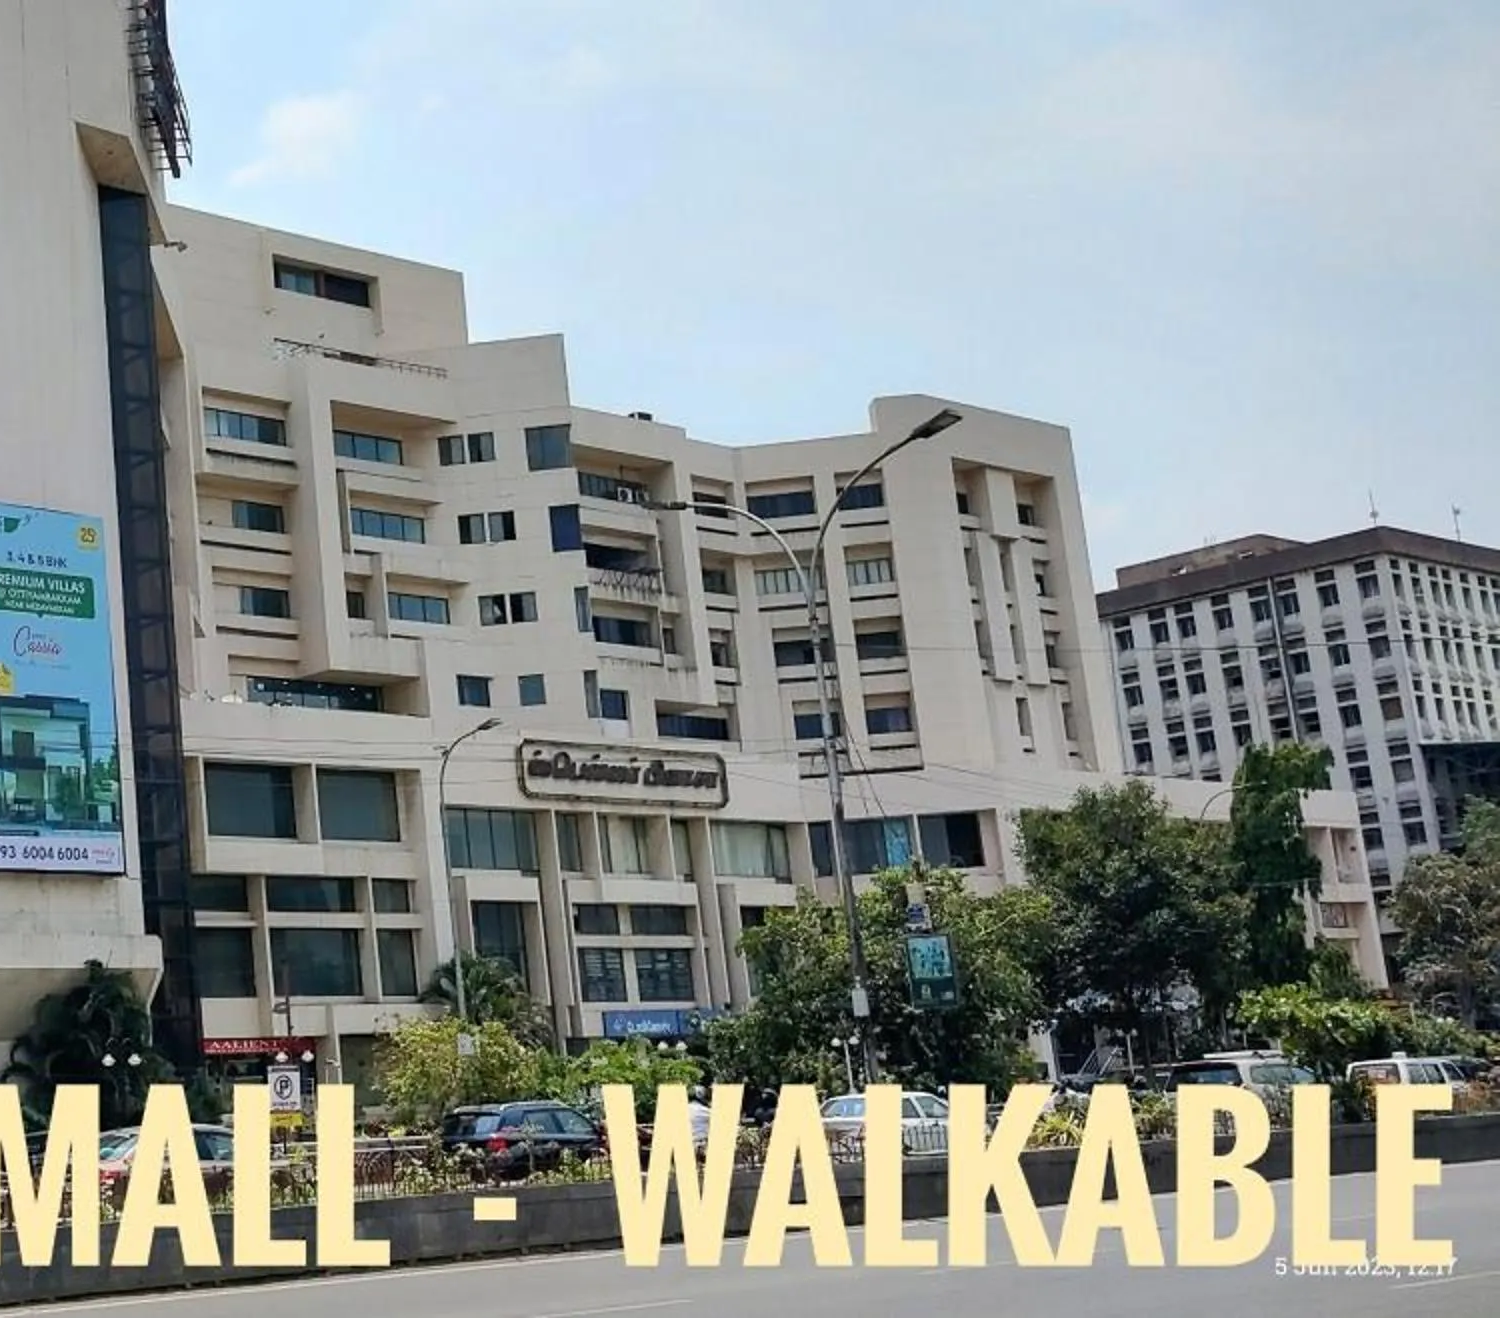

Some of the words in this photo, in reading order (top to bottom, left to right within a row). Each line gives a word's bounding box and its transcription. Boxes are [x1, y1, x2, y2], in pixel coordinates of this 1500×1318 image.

[47, 578, 85, 594] VILLAS
[0, 845, 17, 858] 93
[22, 846, 54, 860] 6004
[57, 847, 89, 860] 6004
